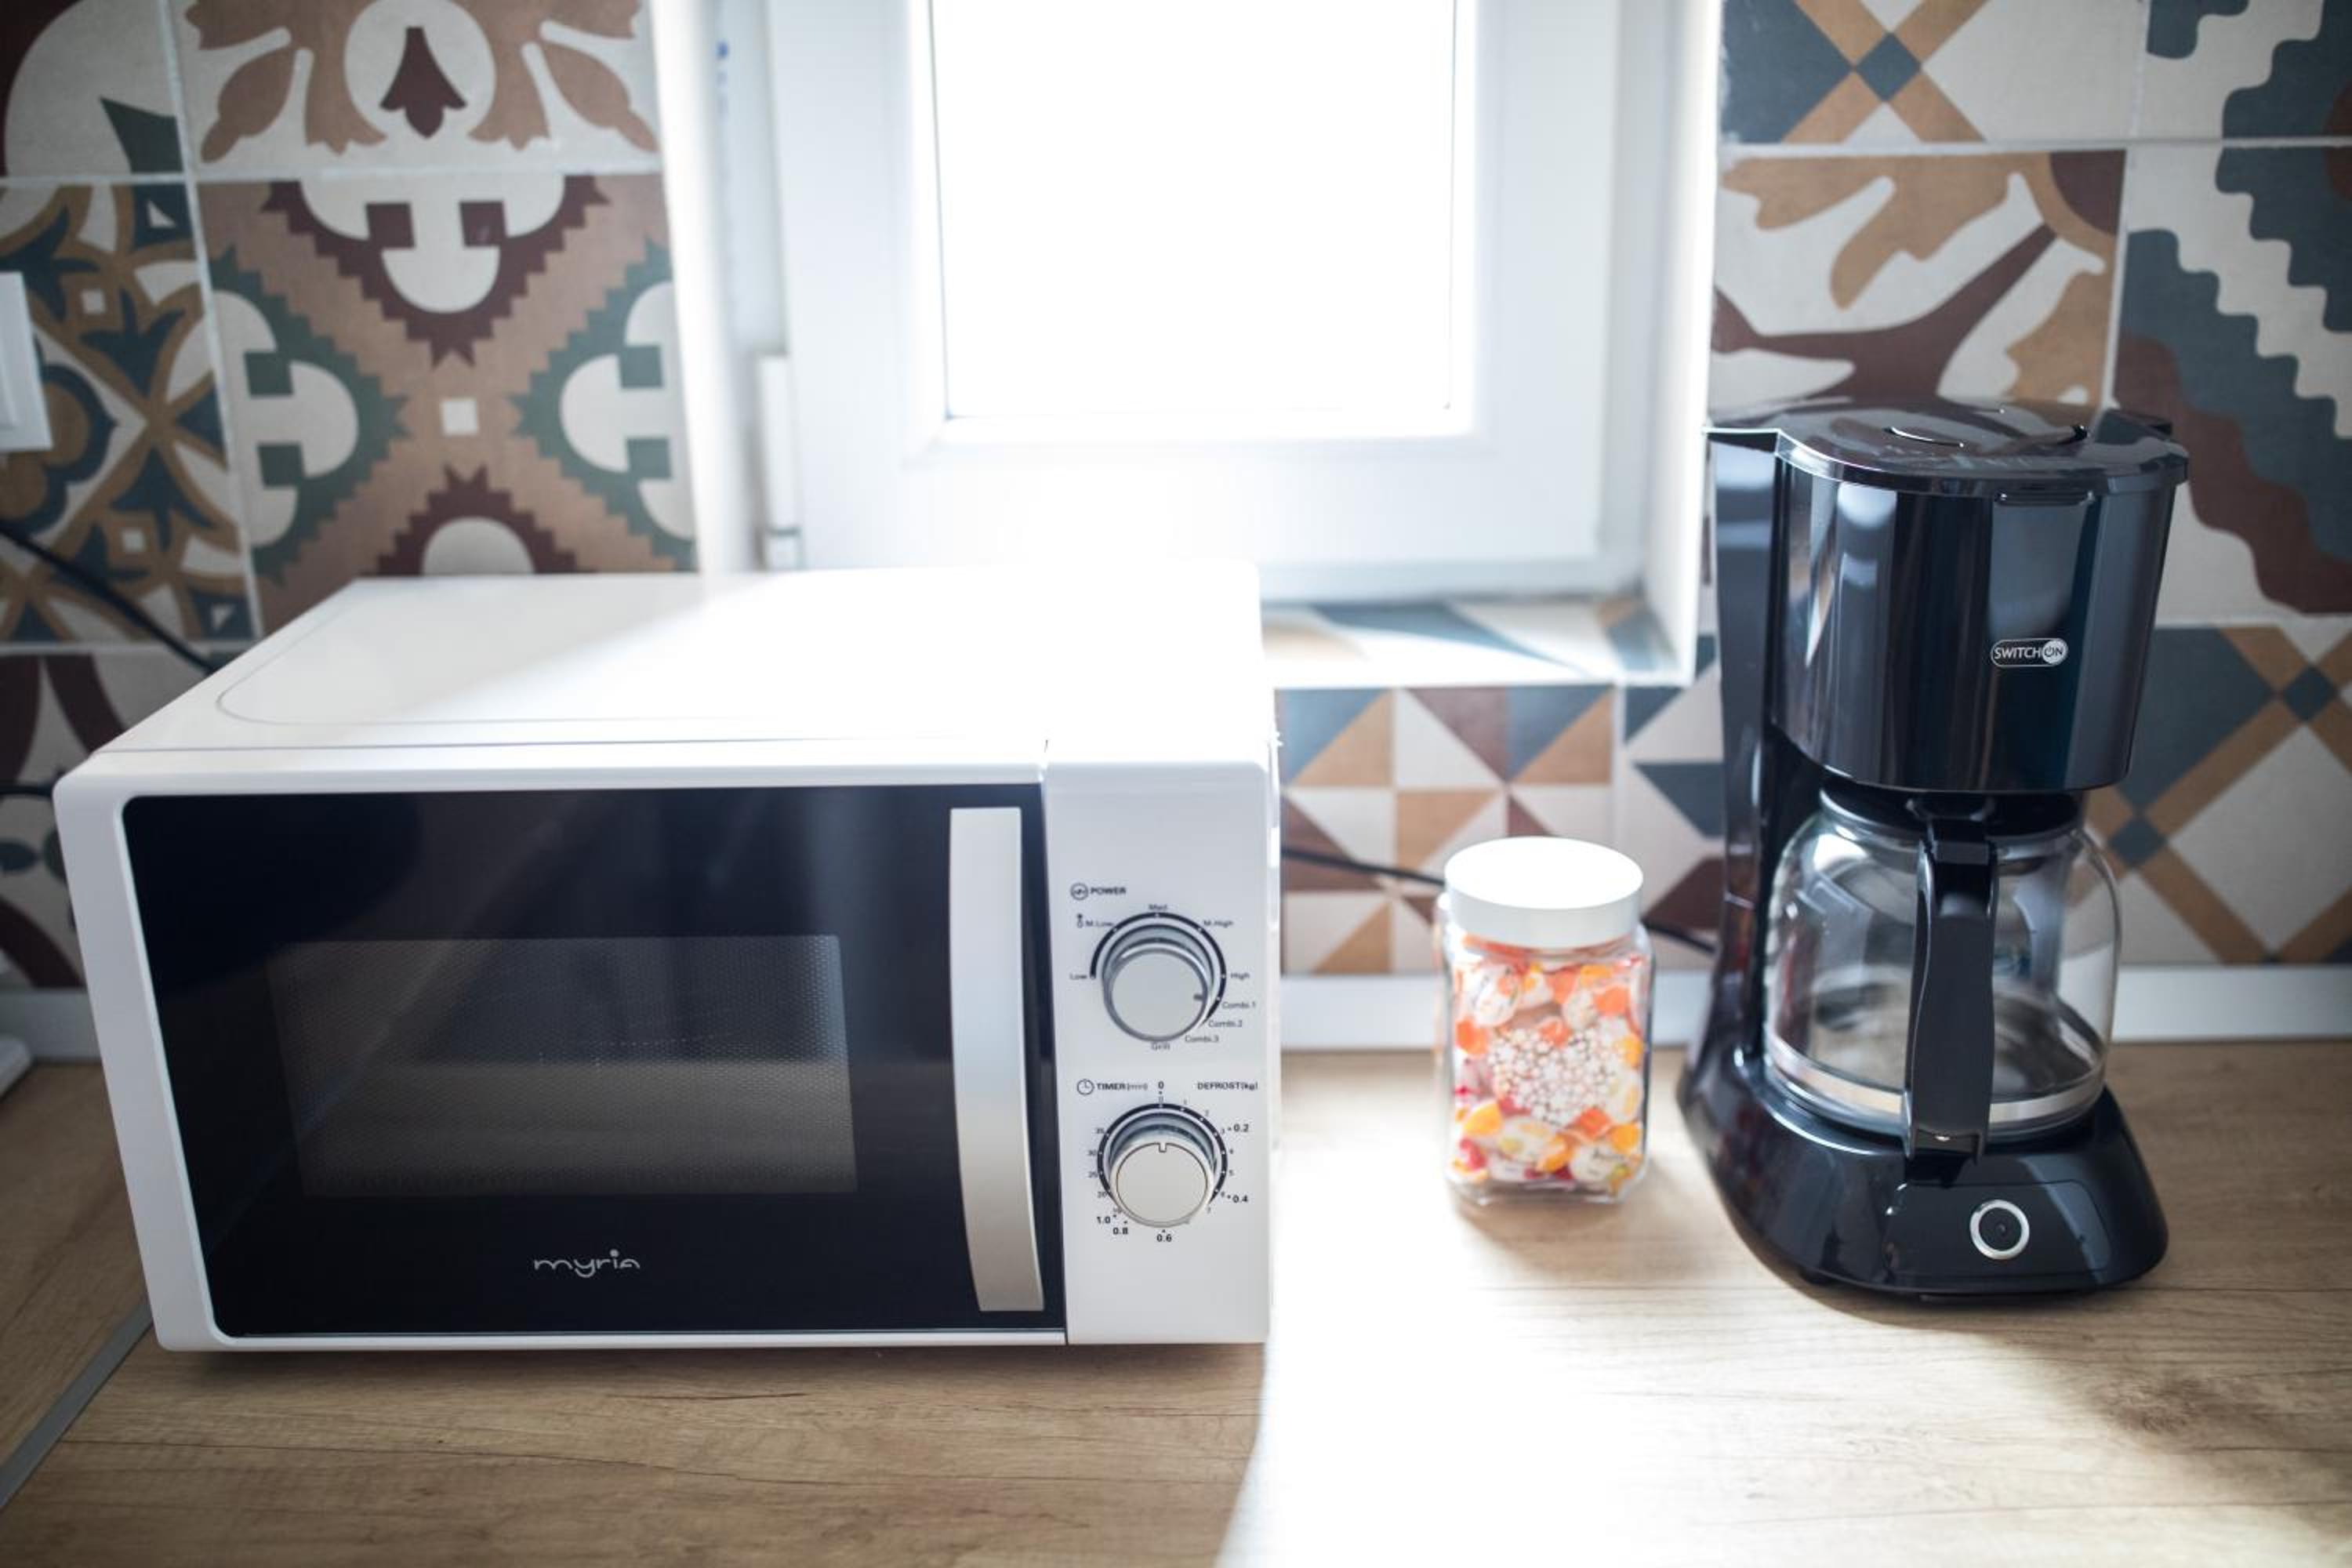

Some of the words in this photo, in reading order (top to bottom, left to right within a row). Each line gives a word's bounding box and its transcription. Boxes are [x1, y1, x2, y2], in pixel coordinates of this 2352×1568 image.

[1069, 972, 1087, 981] Low
[1230, 972, 1250, 981] High
[1158, 1081, 1165, 1090] 0
[1233, 1123, 1250, 1132] 0.2
[1232, 1194, 1249, 1203] 0.4
[1096, 1216, 1111, 1225] 1.0
[1156, 1233, 1173, 1243] 0.6
[534, 1249, 641, 1278] myria
